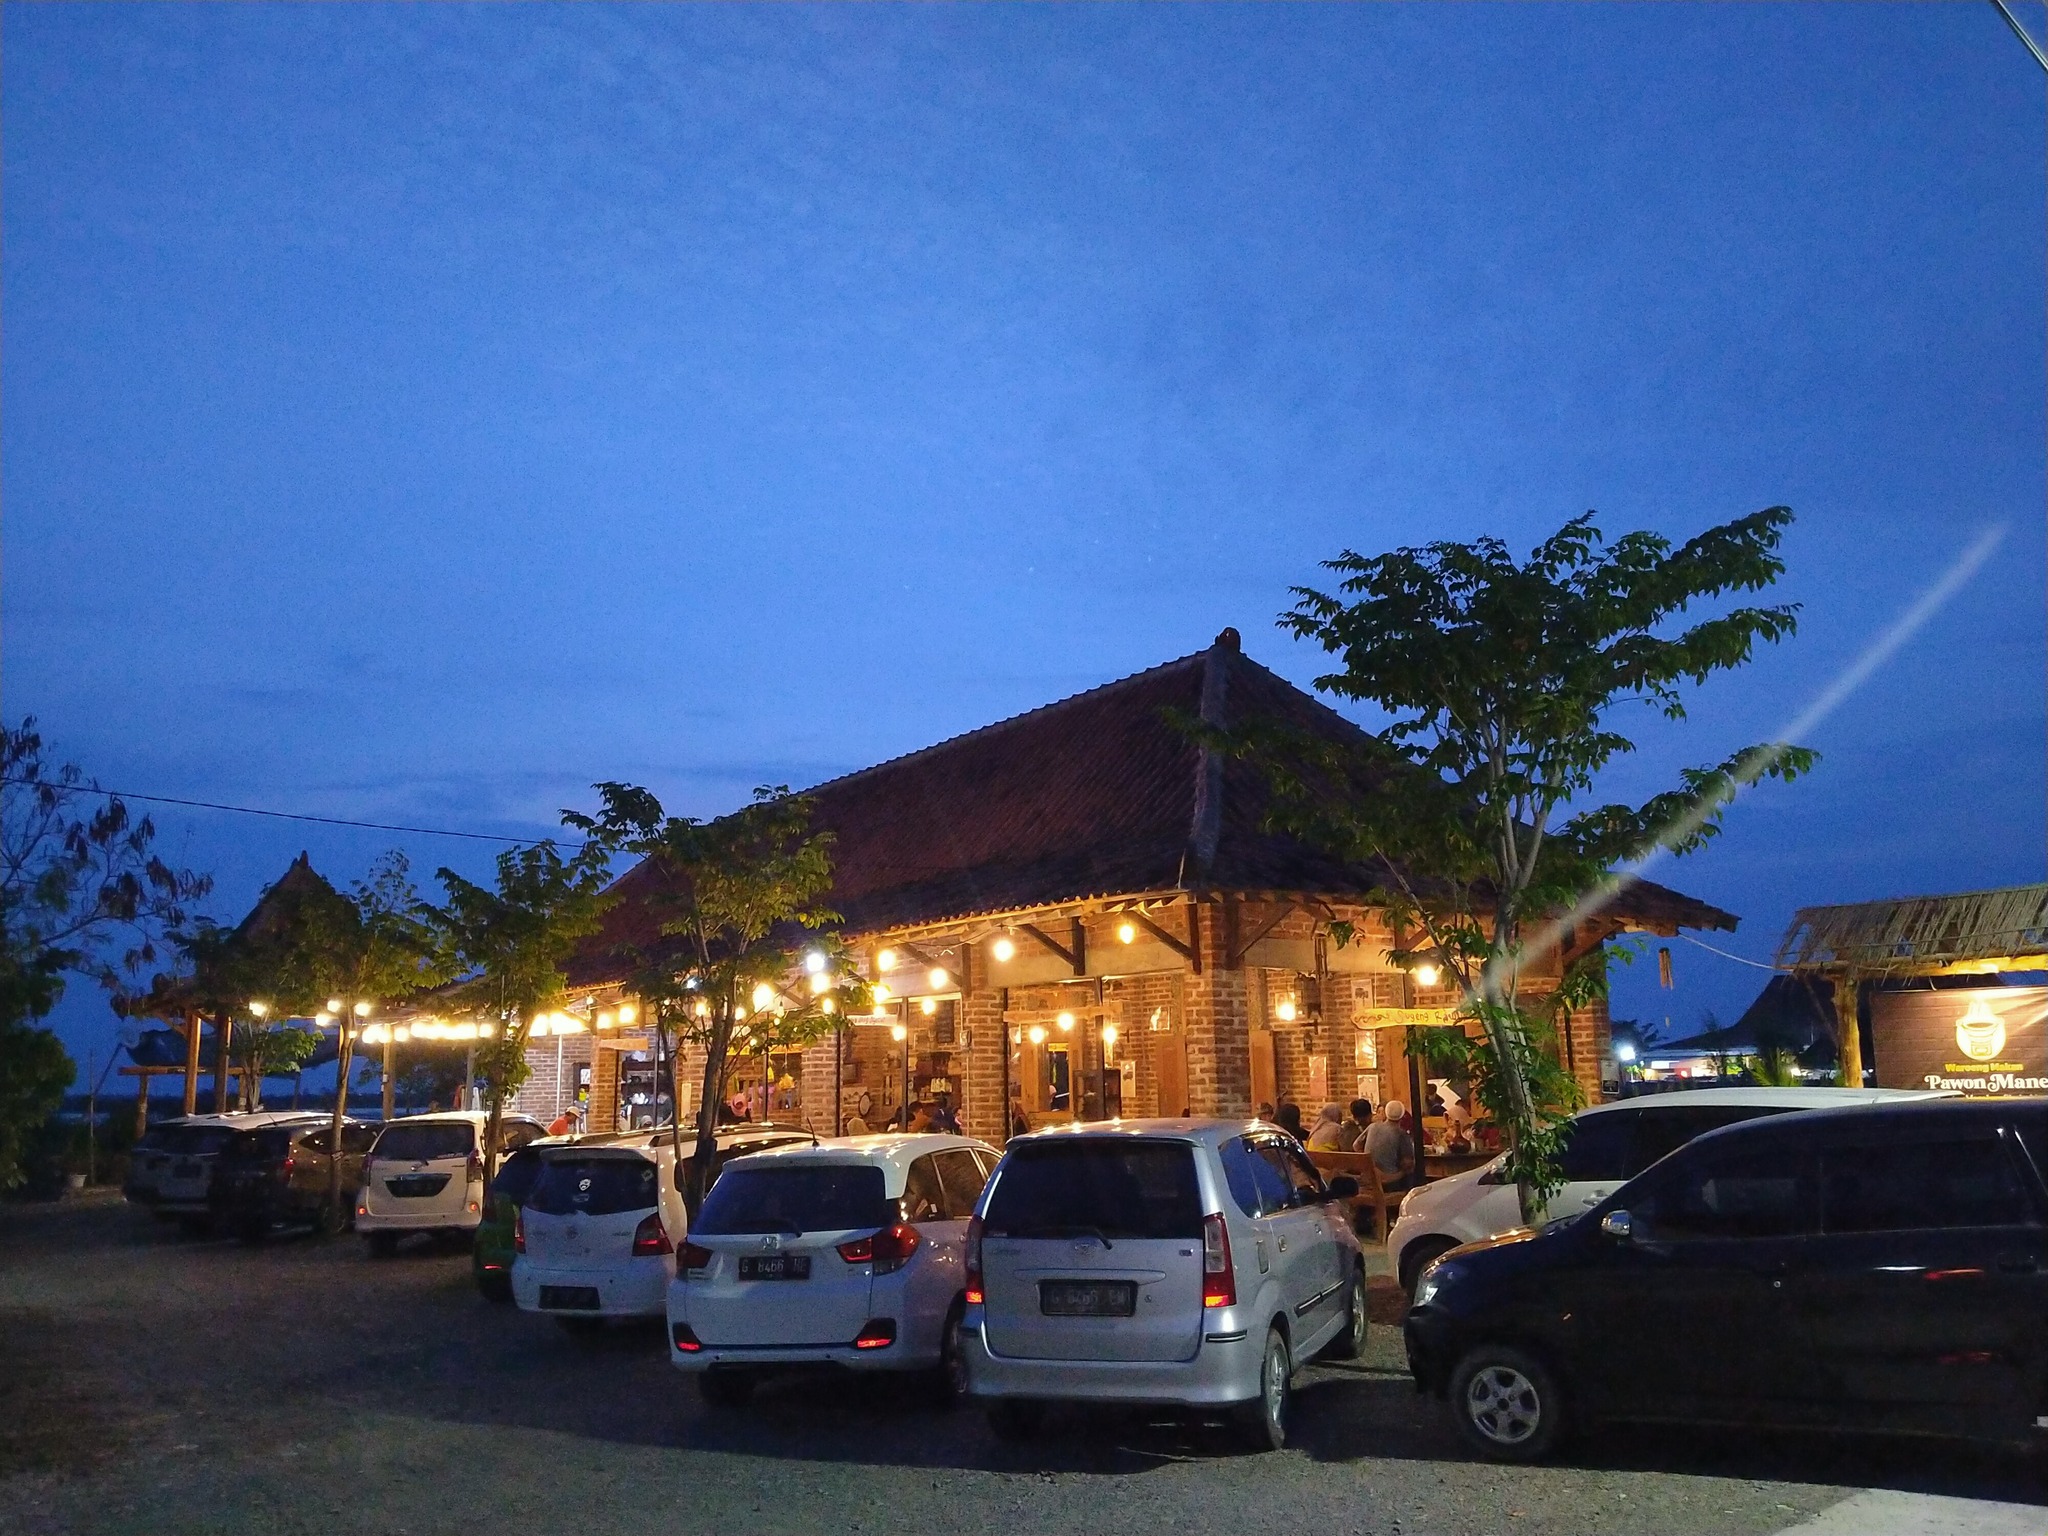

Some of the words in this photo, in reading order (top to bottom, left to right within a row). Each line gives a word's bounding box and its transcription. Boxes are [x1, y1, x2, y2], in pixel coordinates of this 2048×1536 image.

[1394, 1010, 1429, 1023] Sugeng
[1989, 1062, 2024, 1072] Makan
[1924, 1074, 1987, 1090] Pawon
